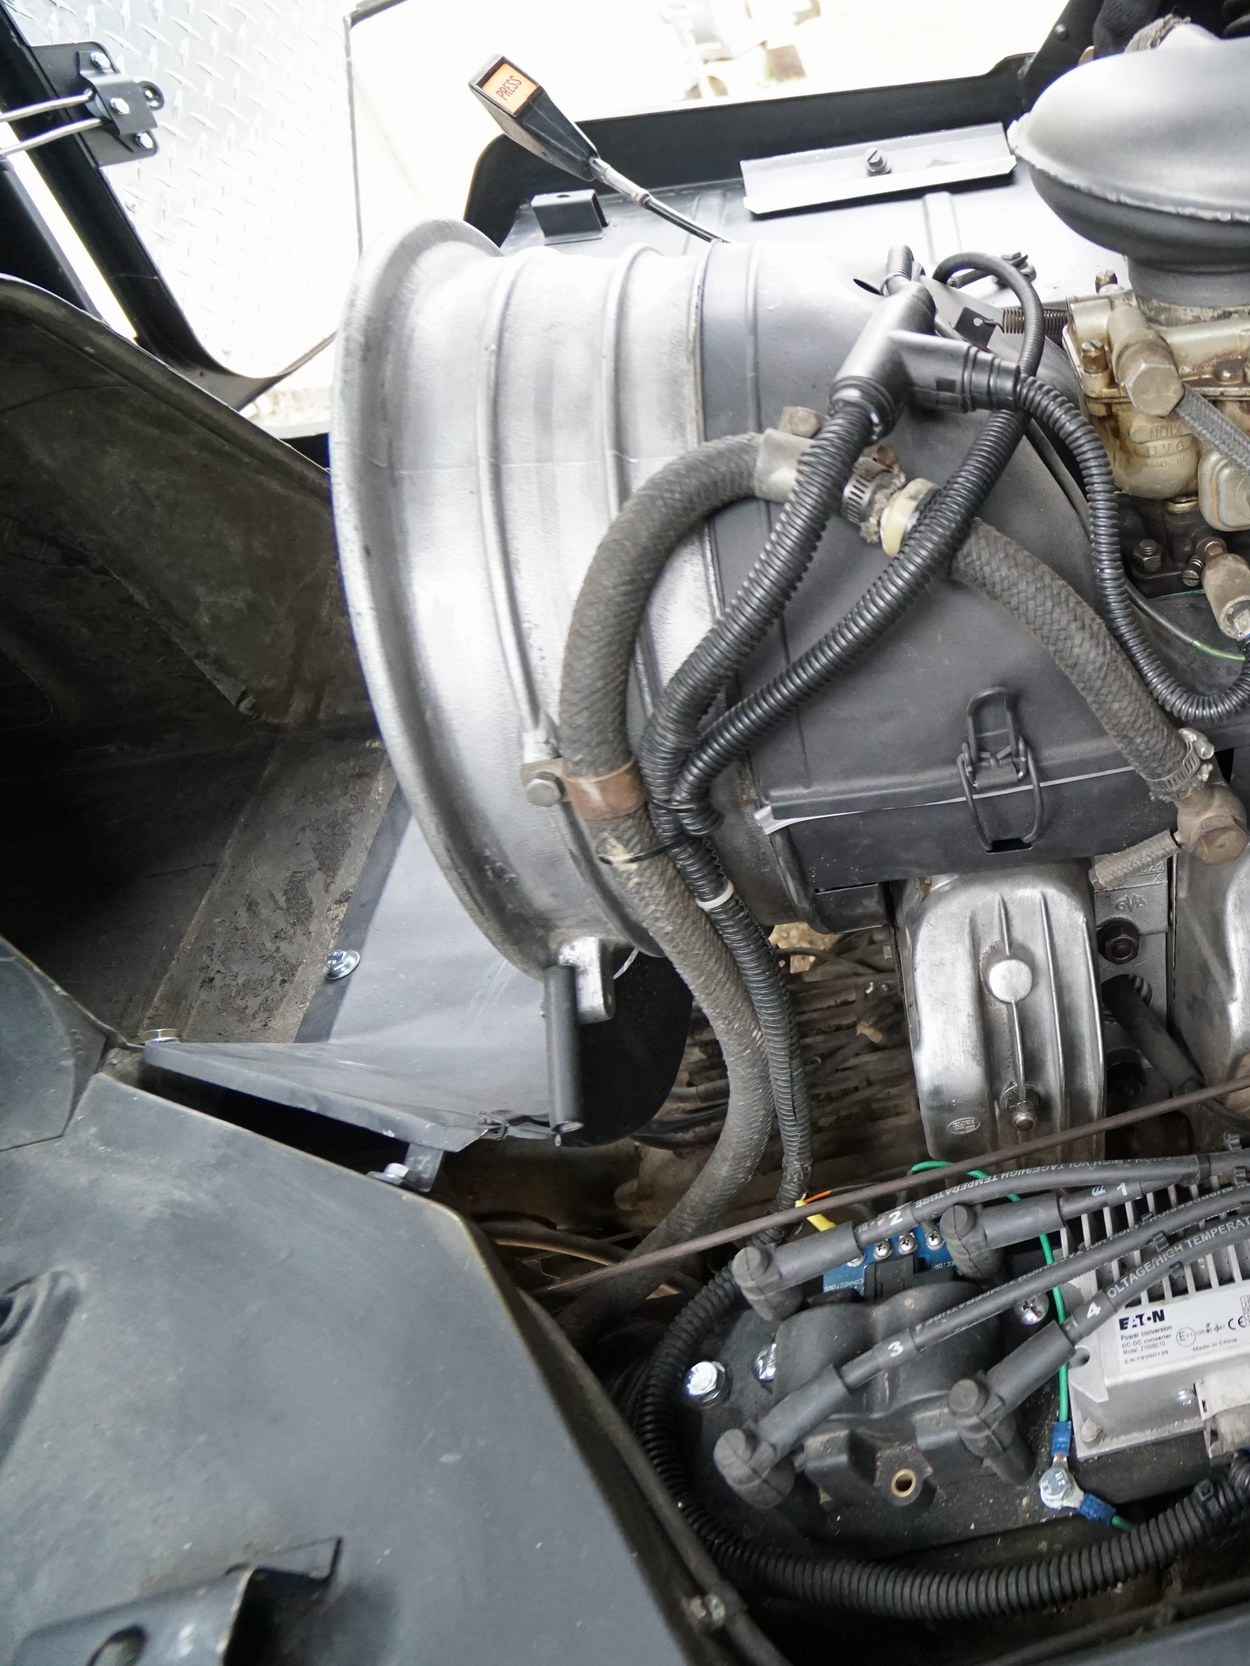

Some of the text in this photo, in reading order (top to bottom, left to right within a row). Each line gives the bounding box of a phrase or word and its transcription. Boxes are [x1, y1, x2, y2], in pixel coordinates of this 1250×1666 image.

[496, 75, 522, 101] PRESS
[1117, 1182, 1128, 1196] 1
[888, 1211, 903, 1226] 2
[1106, 1242, 1185, 1299] OLTAGE/HIGH
[1086, 1302, 1102, 1319] 4
[1120, 1324, 1173, 1342] Power conversion
[1144, 1332, 1171, 1344] converter
[887, 1341, 904, 1358] 3
[1192, 1343, 1211, 1352] Made
[1219, 1336, 1238, 1347] China
